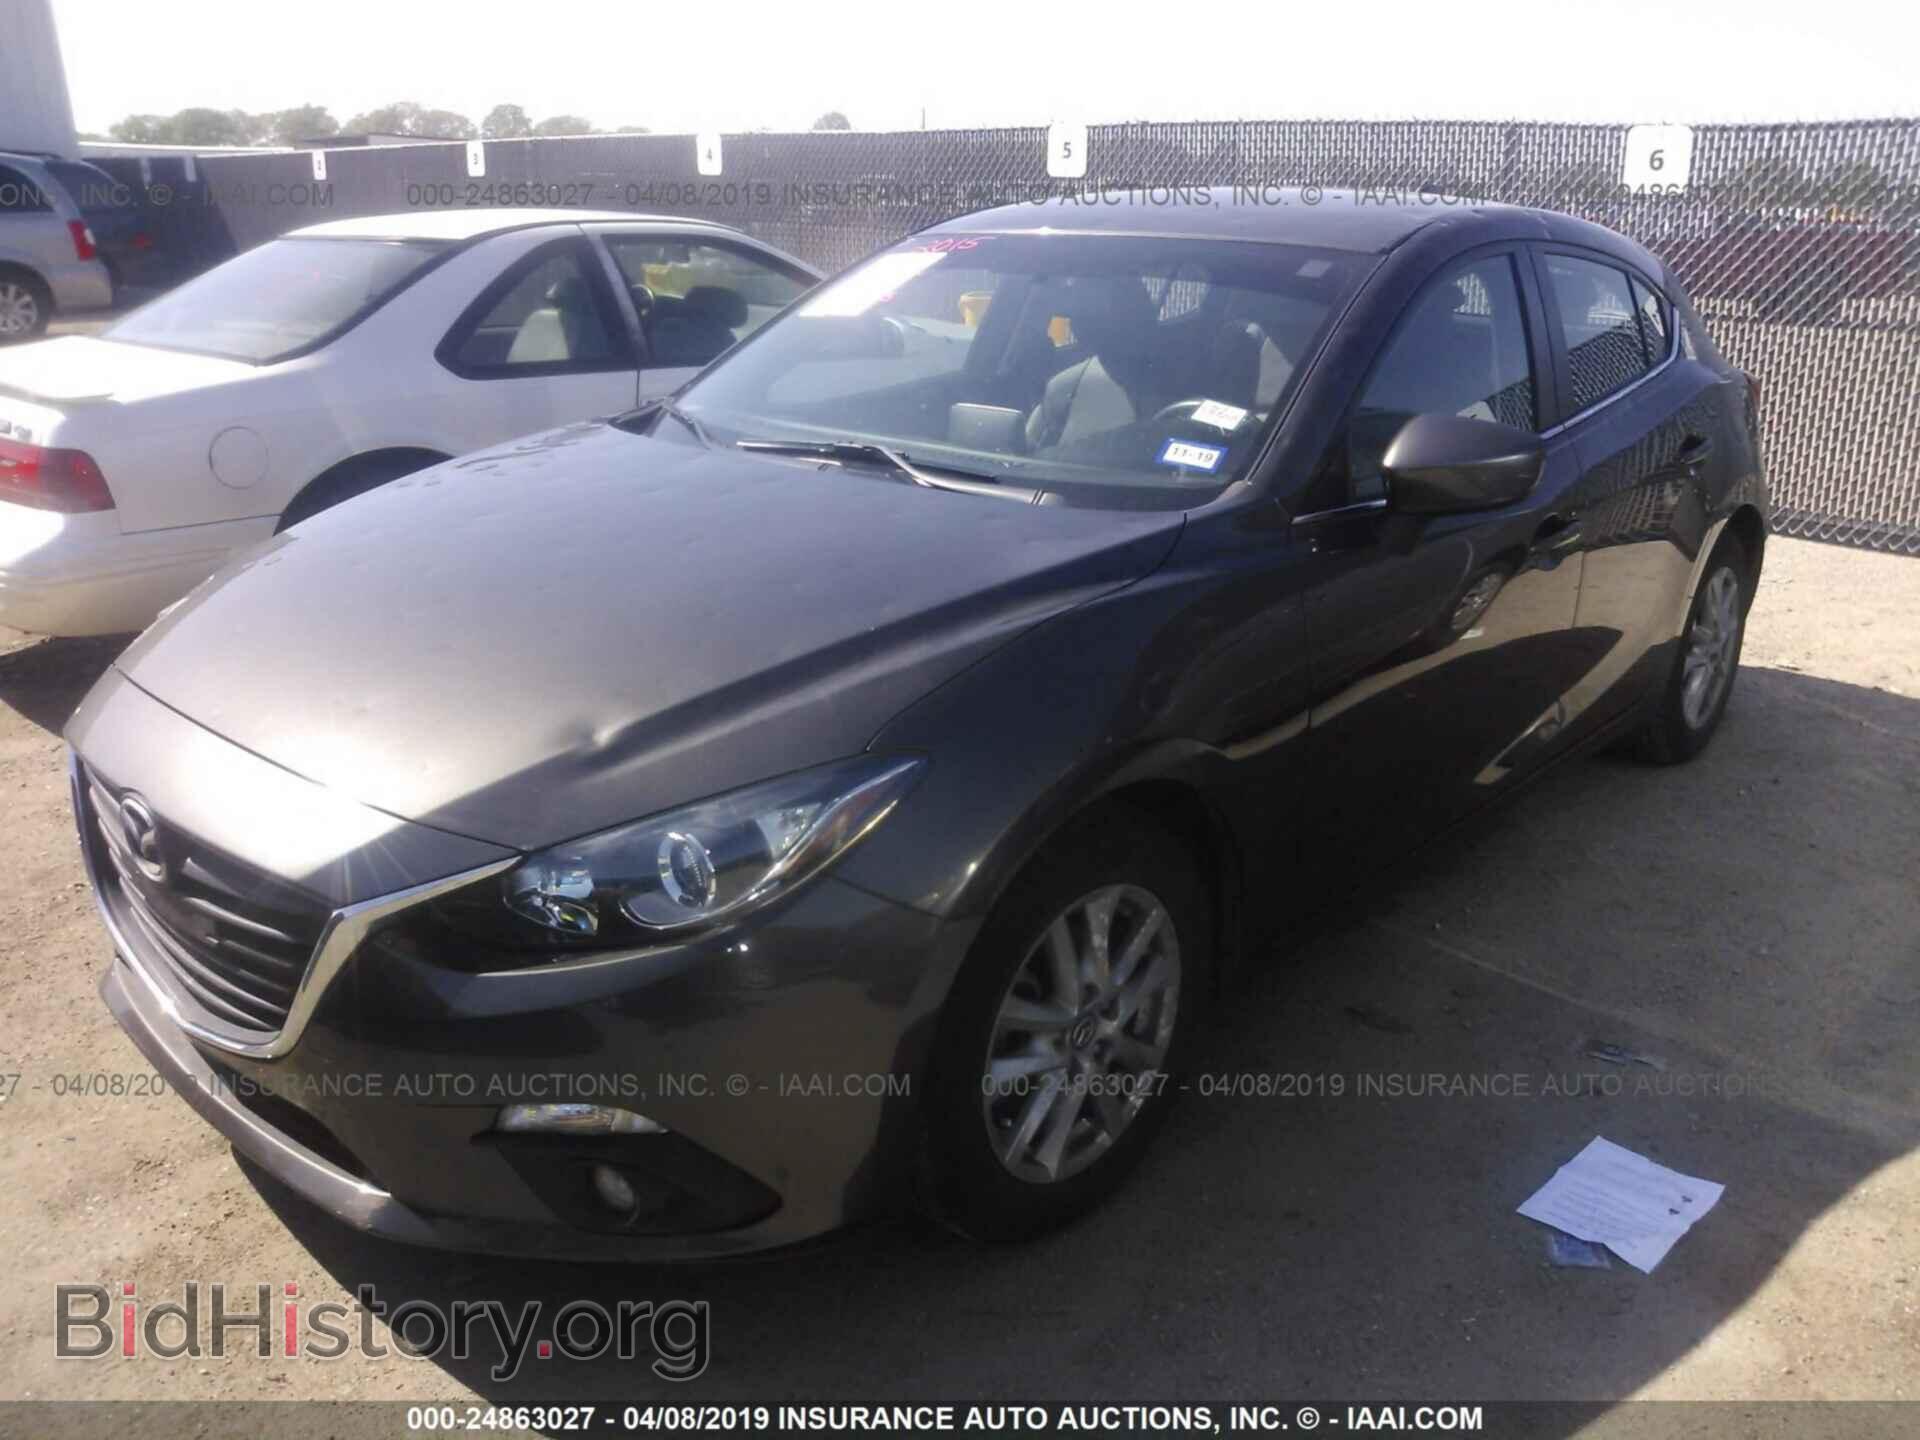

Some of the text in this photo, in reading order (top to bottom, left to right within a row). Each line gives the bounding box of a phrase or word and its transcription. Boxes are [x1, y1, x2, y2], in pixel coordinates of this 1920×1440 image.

[705, 147, 713, 162] 4
[1062, 141, 1072, 159] 5
[1649, 148, 1665, 171] 6
[1172, 446, 1215, 463] 11-19
